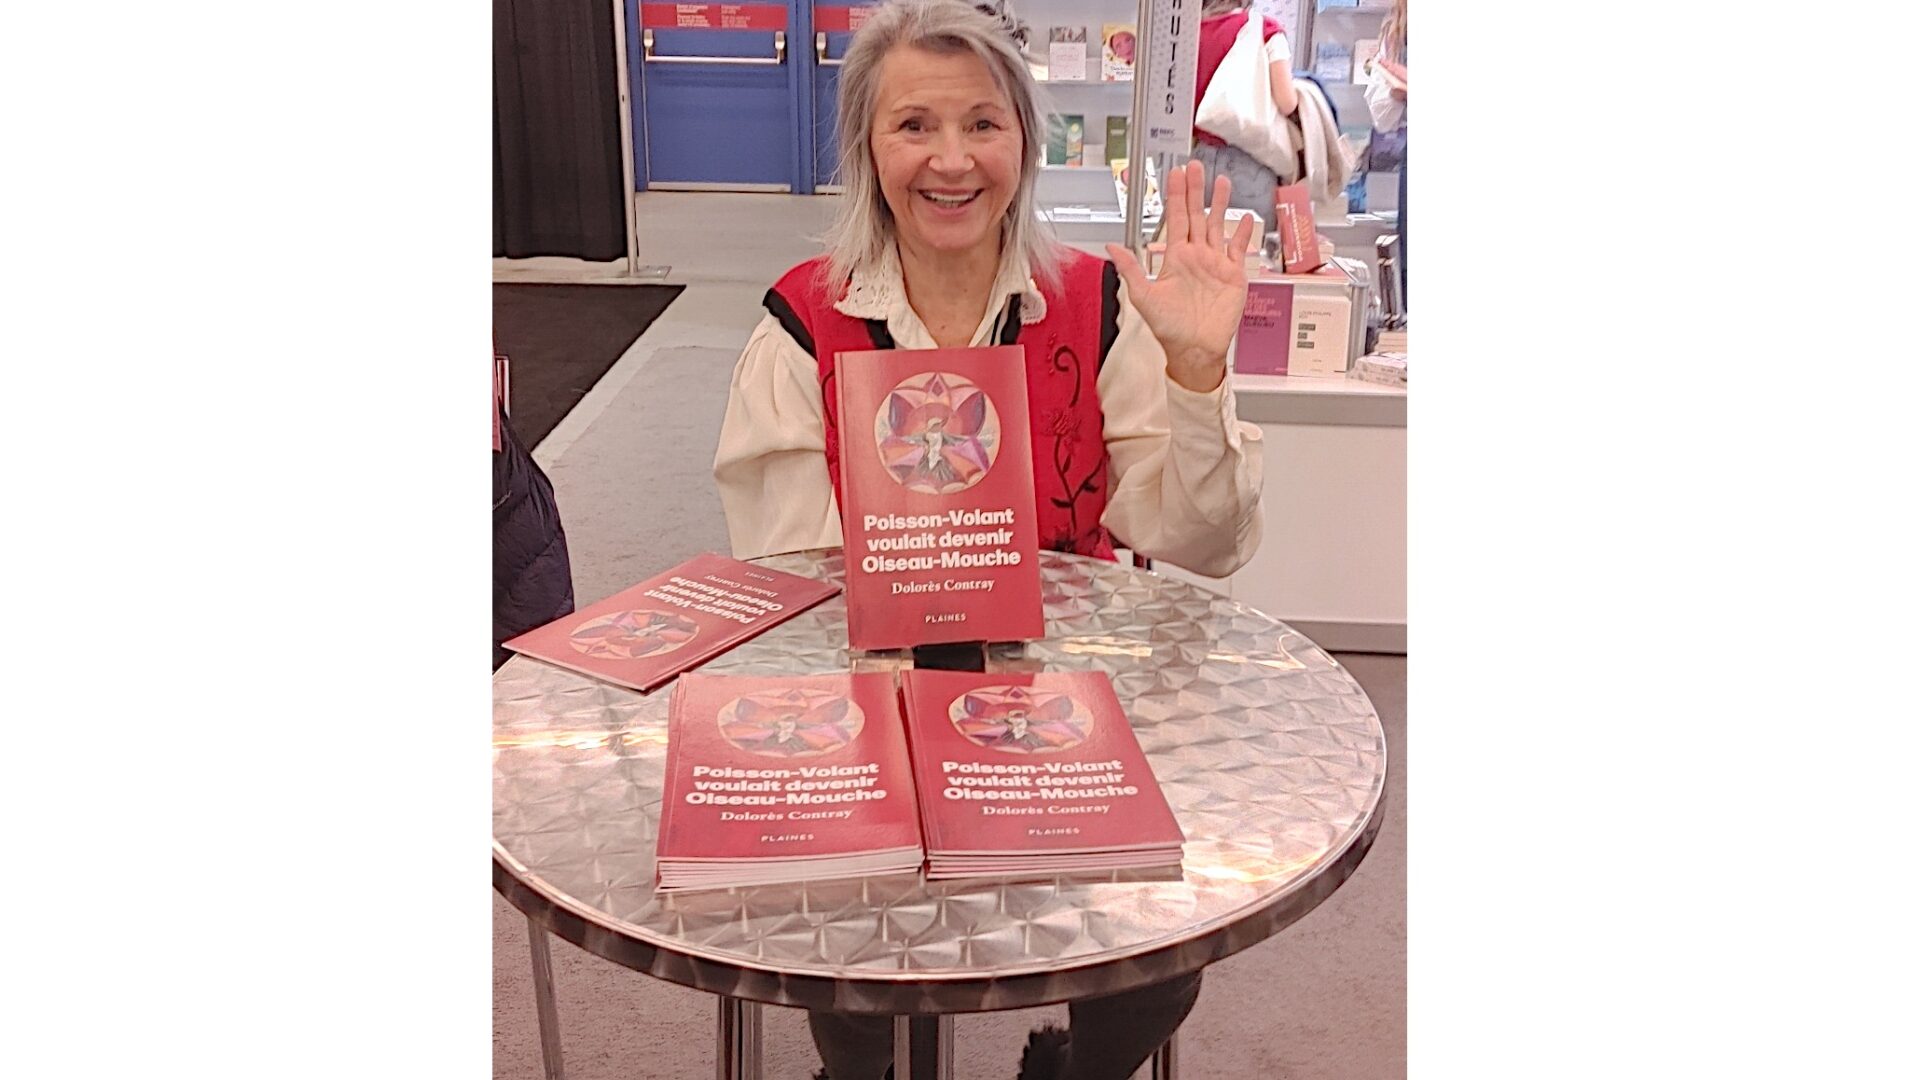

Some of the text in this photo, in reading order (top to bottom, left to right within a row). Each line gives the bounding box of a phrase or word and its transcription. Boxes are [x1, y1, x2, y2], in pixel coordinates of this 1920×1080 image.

[863, 507, 1015, 531] Poisson-Volant
[866, 528, 1014, 552] voulait devenir
[862, 549, 1022, 573] Oiseau-Mouche
[669, 576, 784, 612] Oiseau-Mouche
[891, 579, 995, 595] Dolorès Contray
[643, 589, 757, 624] Poisson-Volant
[659, 584, 767, 616] voulait devenir
[925, 613, 966, 623] PLAINES
[693, 763, 879, 779] Poisson-Volant
[942, 759, 1124, 774] Poisson-Volant
[694, 776, 878, 792] voulait devenir
[948, 772, 1125, 787] voulait devenir
[685, 789, 887, 805] Oiseau-Mouche
[943, 784, 1139, 800] Oiseau-Mouche
[720, 809, 853, 822] Dolorès Contray
[982, 804, 1111, 815] Dolorès Contray
[761, 833, 815, 842] PLAINES
[1028, 828, 1080, 836] PLAINES
